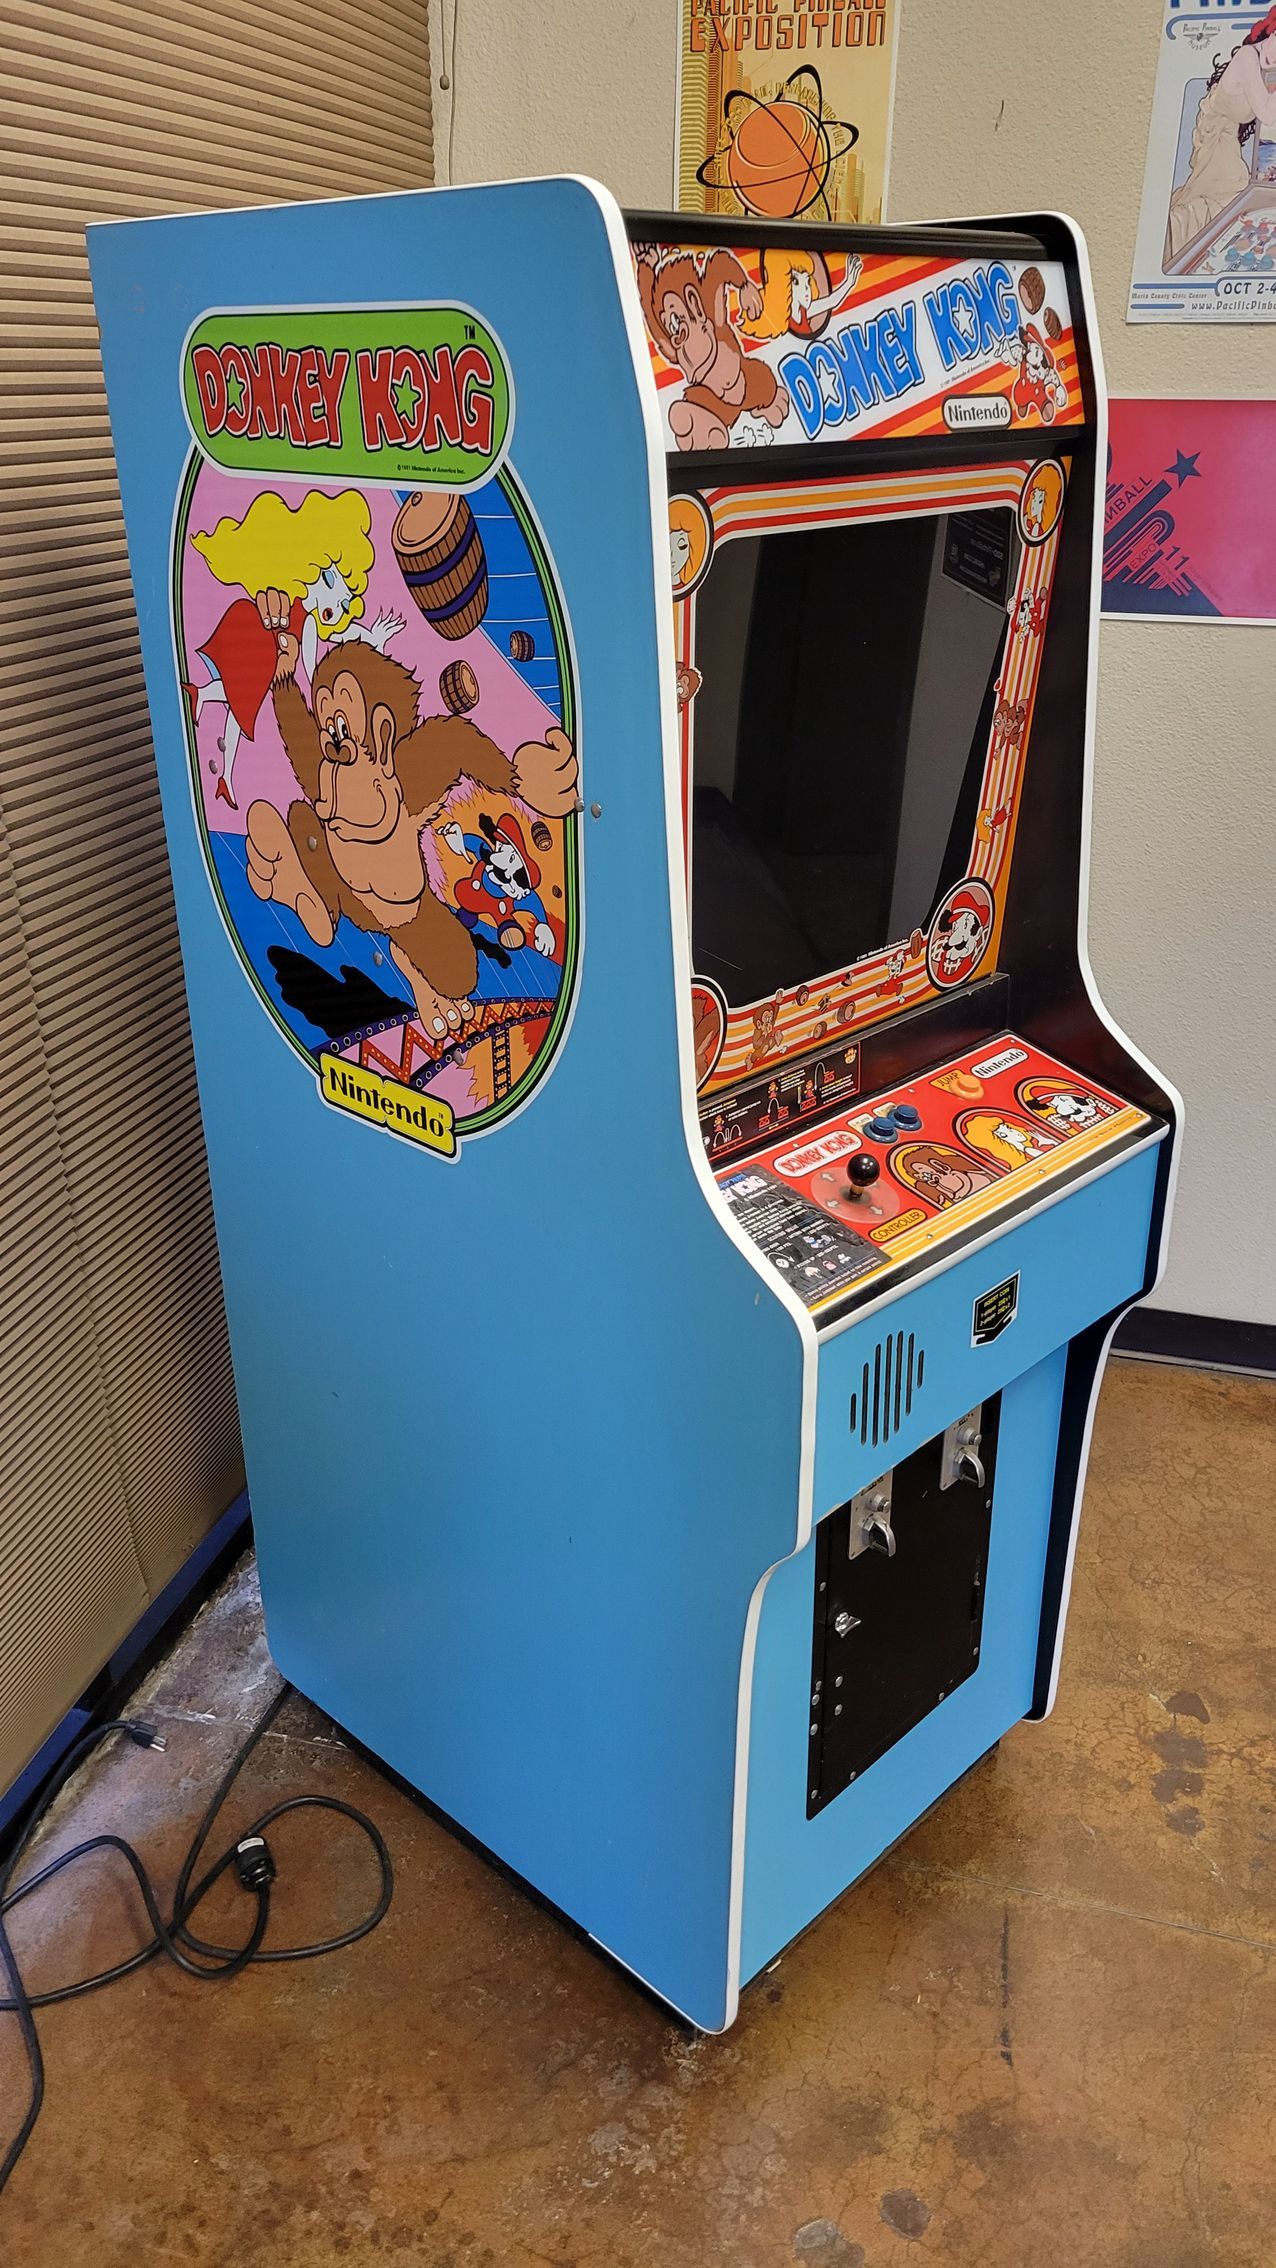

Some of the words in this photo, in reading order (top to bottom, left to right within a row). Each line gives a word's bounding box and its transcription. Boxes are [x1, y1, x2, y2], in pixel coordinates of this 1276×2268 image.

[690, 10, 886, 52] EXPOSITION
[1223, 282, 1251, 294] OCT
[464, 325, 476, 340] TM
[777, 301, 924, 440] DONKEY
[925, 261, 1019, 369] KONG
[192, 342, 350, 450] DONKEY
[355, 343, 494, 457] KONG
[948, 402, 1007, 421] Nintendo
[1129, 543, 1157, 569] EXPO
[974, 1050, 1024, 1077] Nintendo
[936, 1072, 960, 1087] JUMP
[329, 1067, 444, 1138] Nintendo
[778, 1146, 827, 1174] DONKEY
[820, 1134, 858, 1155] KONG
[873, 1211, 923, 1240] CONTROLLER
